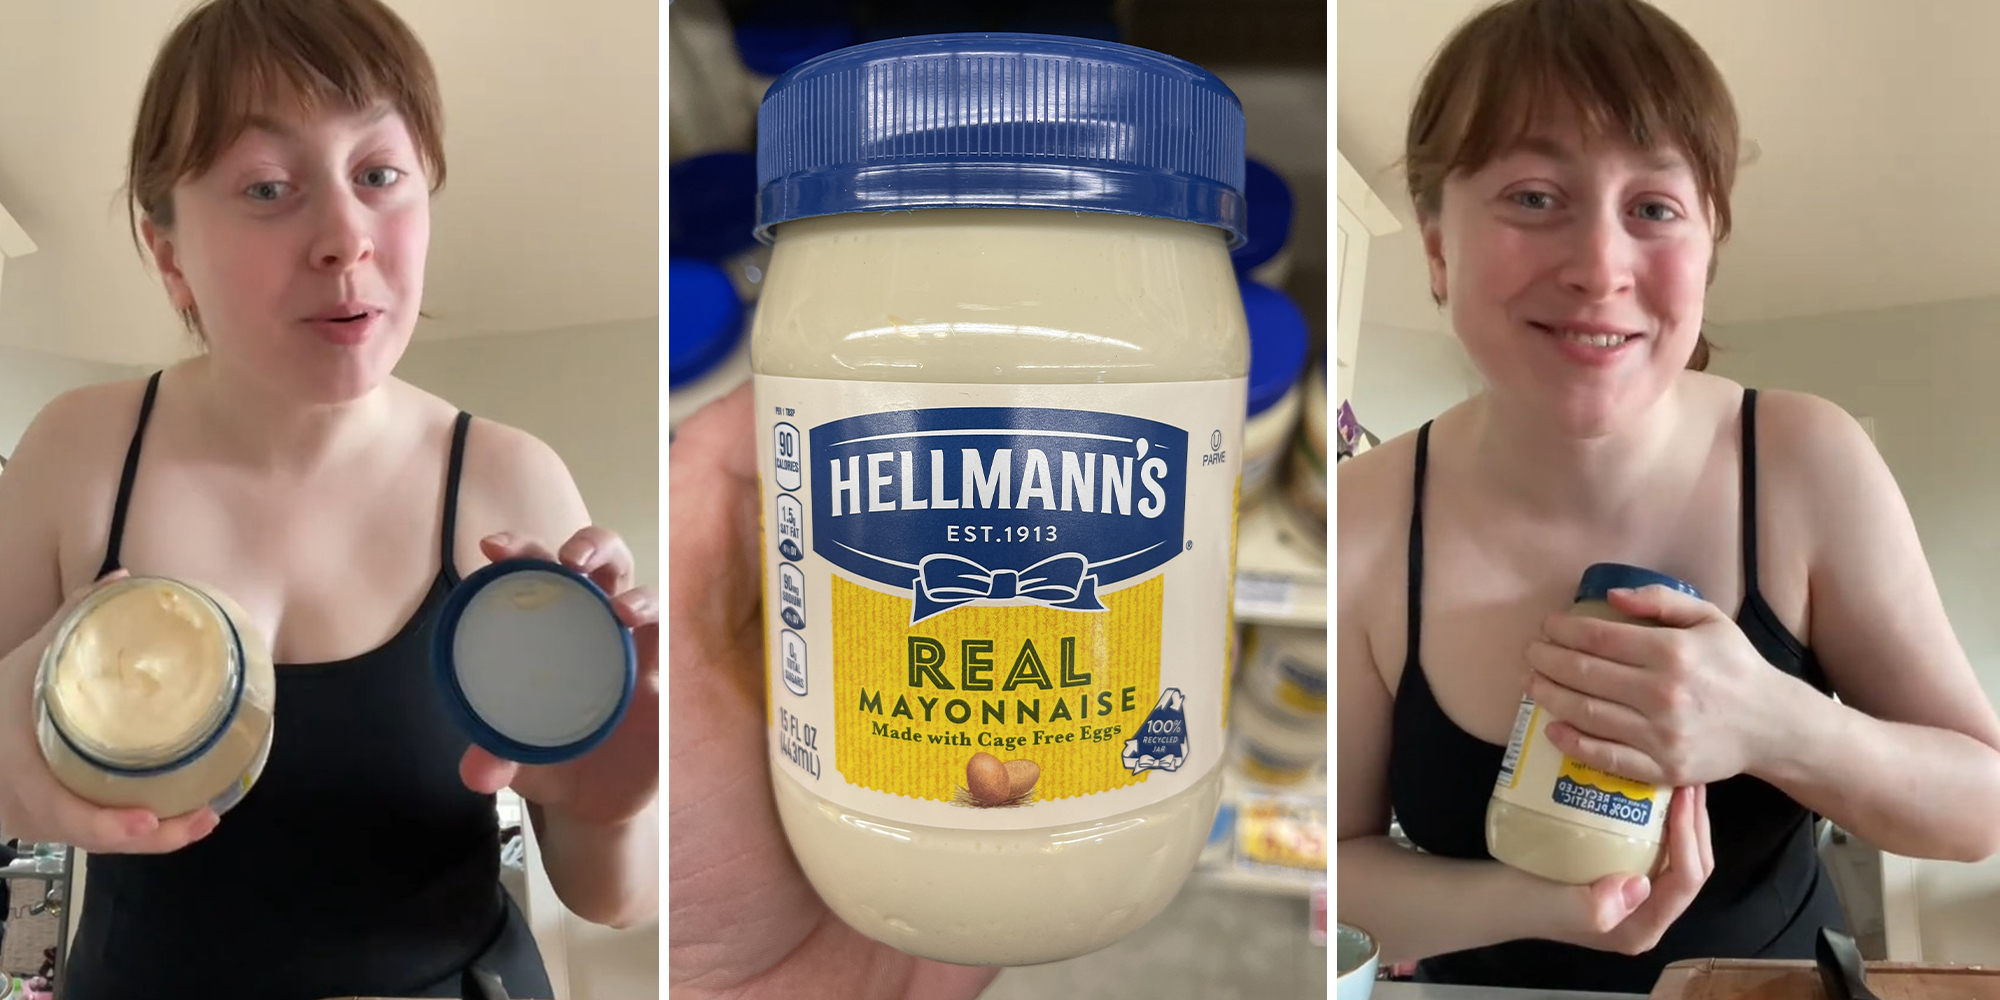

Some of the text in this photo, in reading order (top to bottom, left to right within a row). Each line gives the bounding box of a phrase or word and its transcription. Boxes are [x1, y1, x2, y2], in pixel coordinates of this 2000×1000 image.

[779, 431, 793, 458] 90
[776, 457, 799, 473] CALORIES
[1202, 451, 1226, 467] PARVE
[830, 437, 1168, 519] HELLMANN'S
[780, 524, 800, 539] SAT FAT
[783, 591, 802, 609] SODIUM
[786, 656, 801, 675] TOTAL
[907, 636, 1092, 691] REAL
[785, 668, 805, 689] SUGARS
[859, 686, 1136, 725] MAYONNAISE
[780, 706, 817, 751] 15 FL OZ
[1147, 719, 1182, 734] 100%
[872, 721, 1122, 752] Made with Cage Free Eggs
[1143, 736, 1179, 744] RECYCLED
[1152, 745, 1166, 753] JAR
